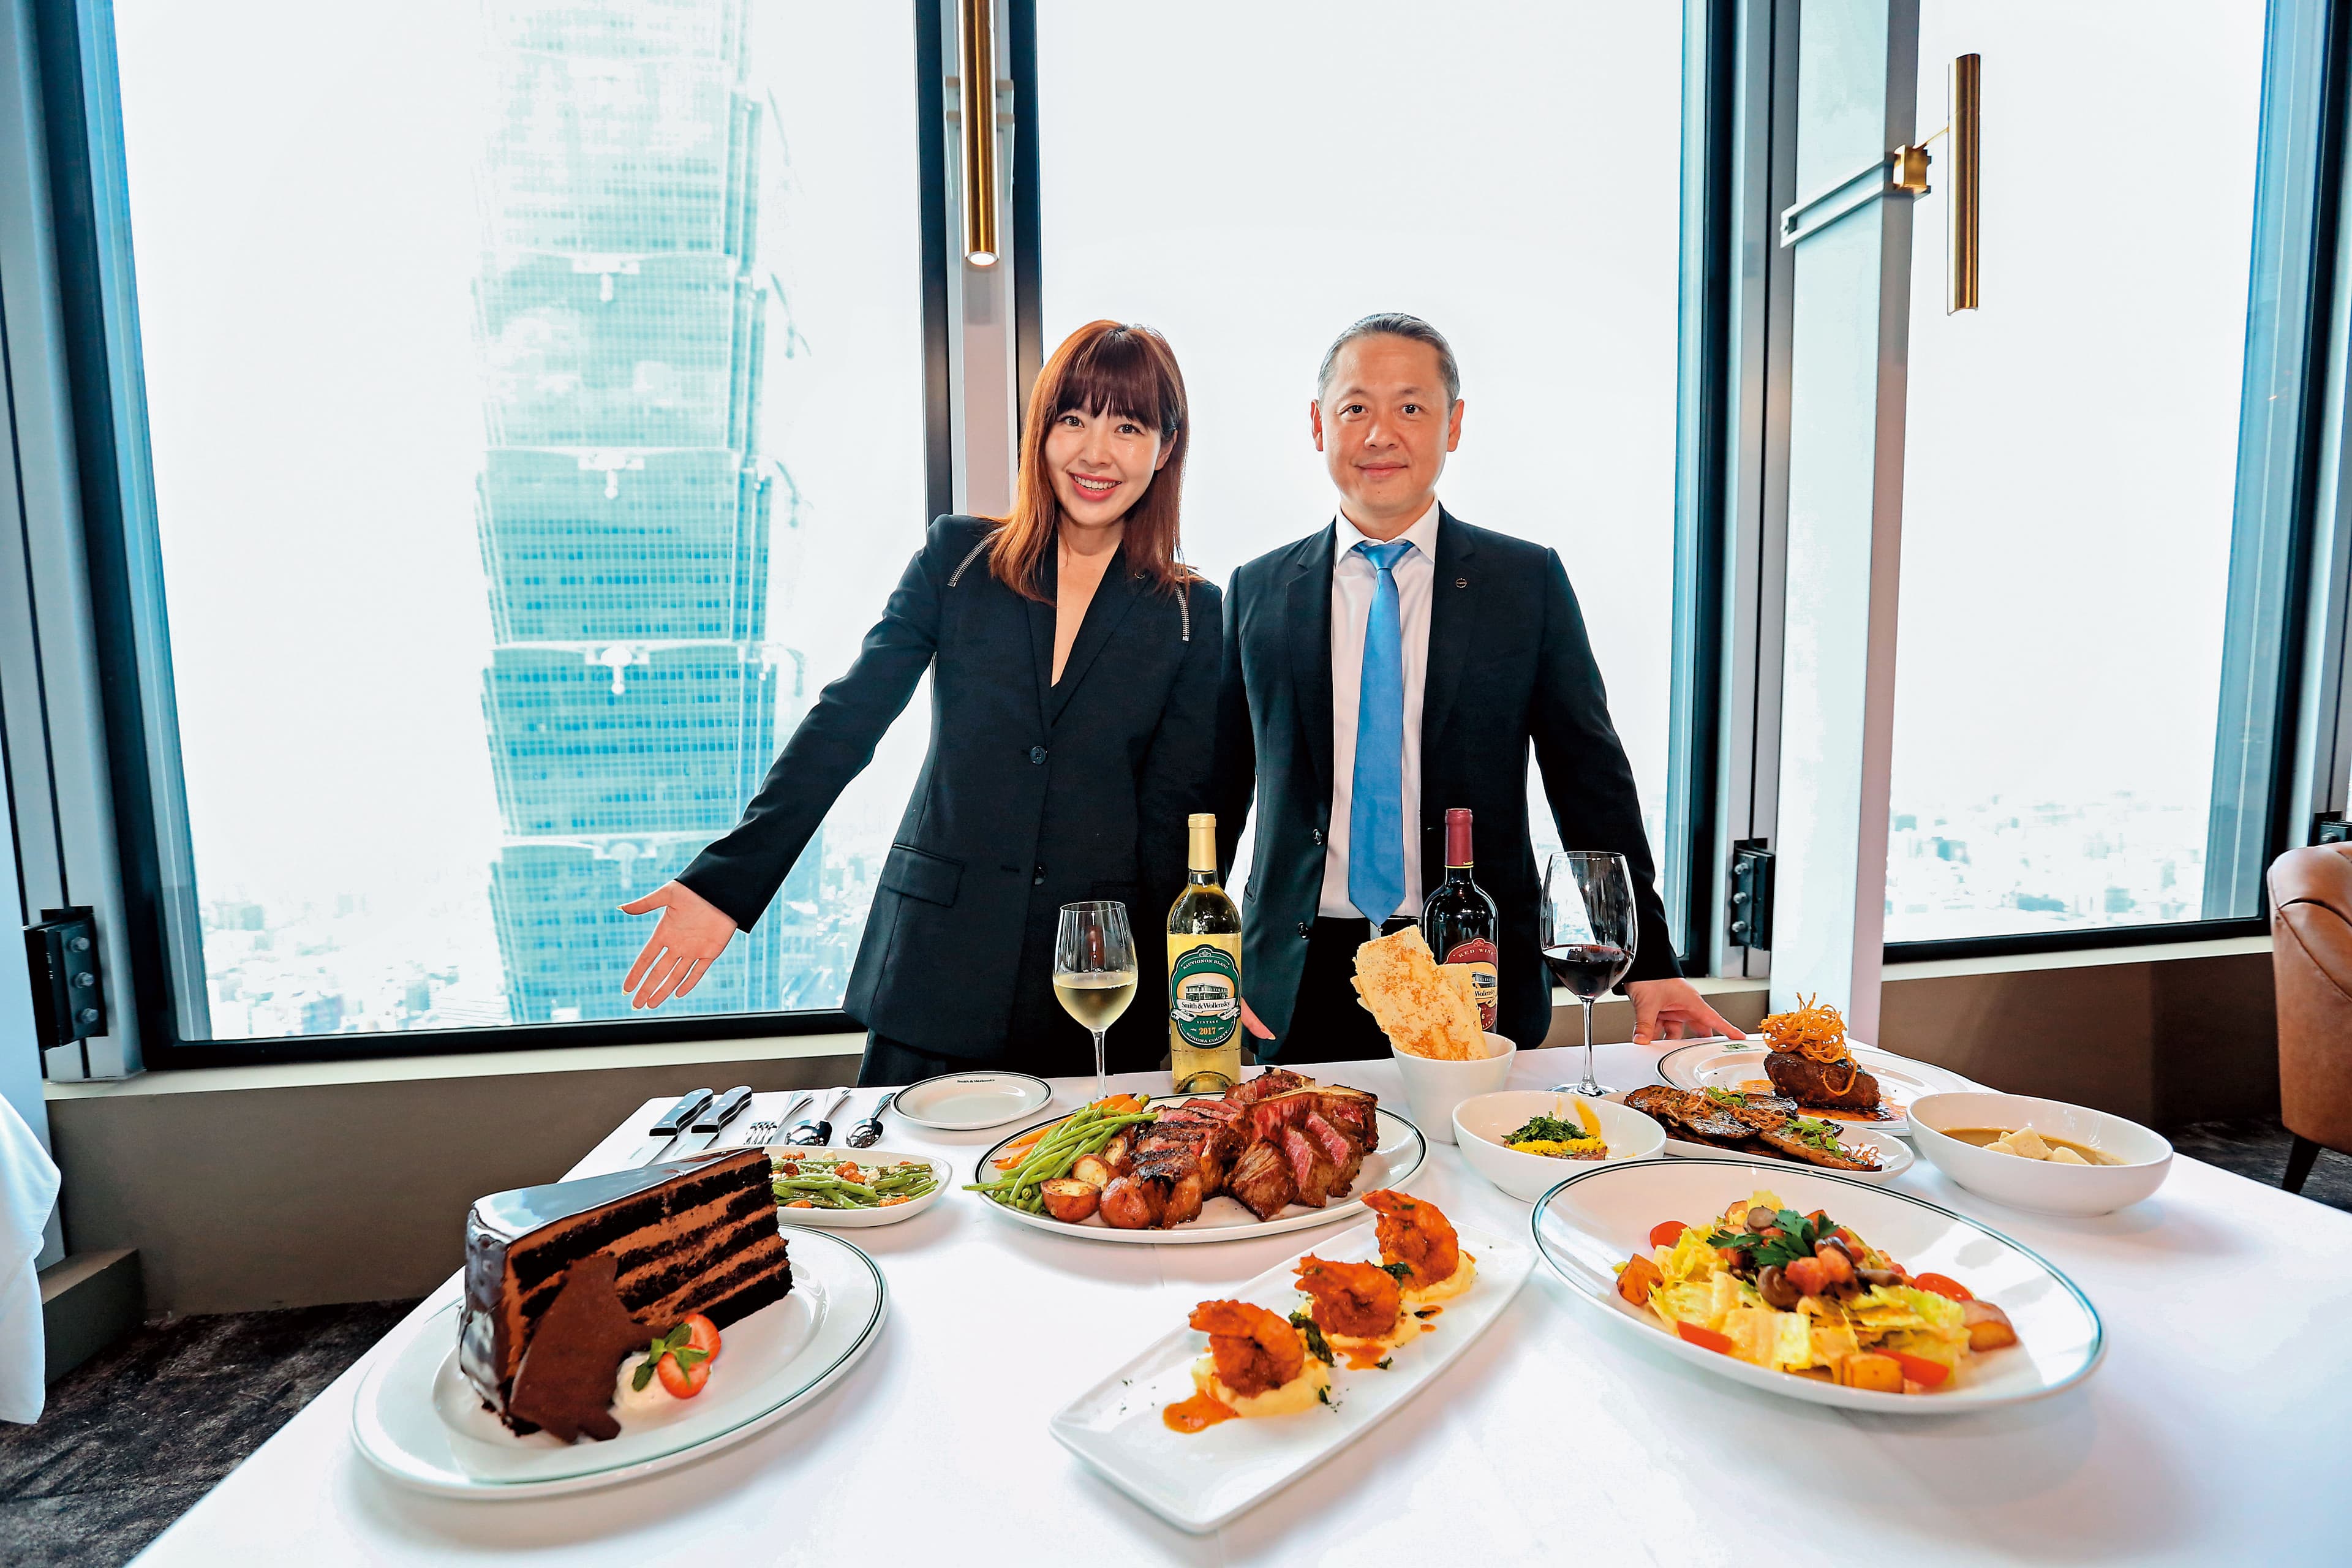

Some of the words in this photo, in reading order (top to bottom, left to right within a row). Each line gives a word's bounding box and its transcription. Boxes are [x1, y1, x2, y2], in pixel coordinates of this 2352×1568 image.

[1458, 949, 1475, 958] RED
[1183, 959, 1213, 970] SAUVIGNON
[1214, 960, 1229, 970] BLANC
[1186, 1032, 1207, 1043] SONOMA
[1209, 1031, 1229, 1042] COUNTY
